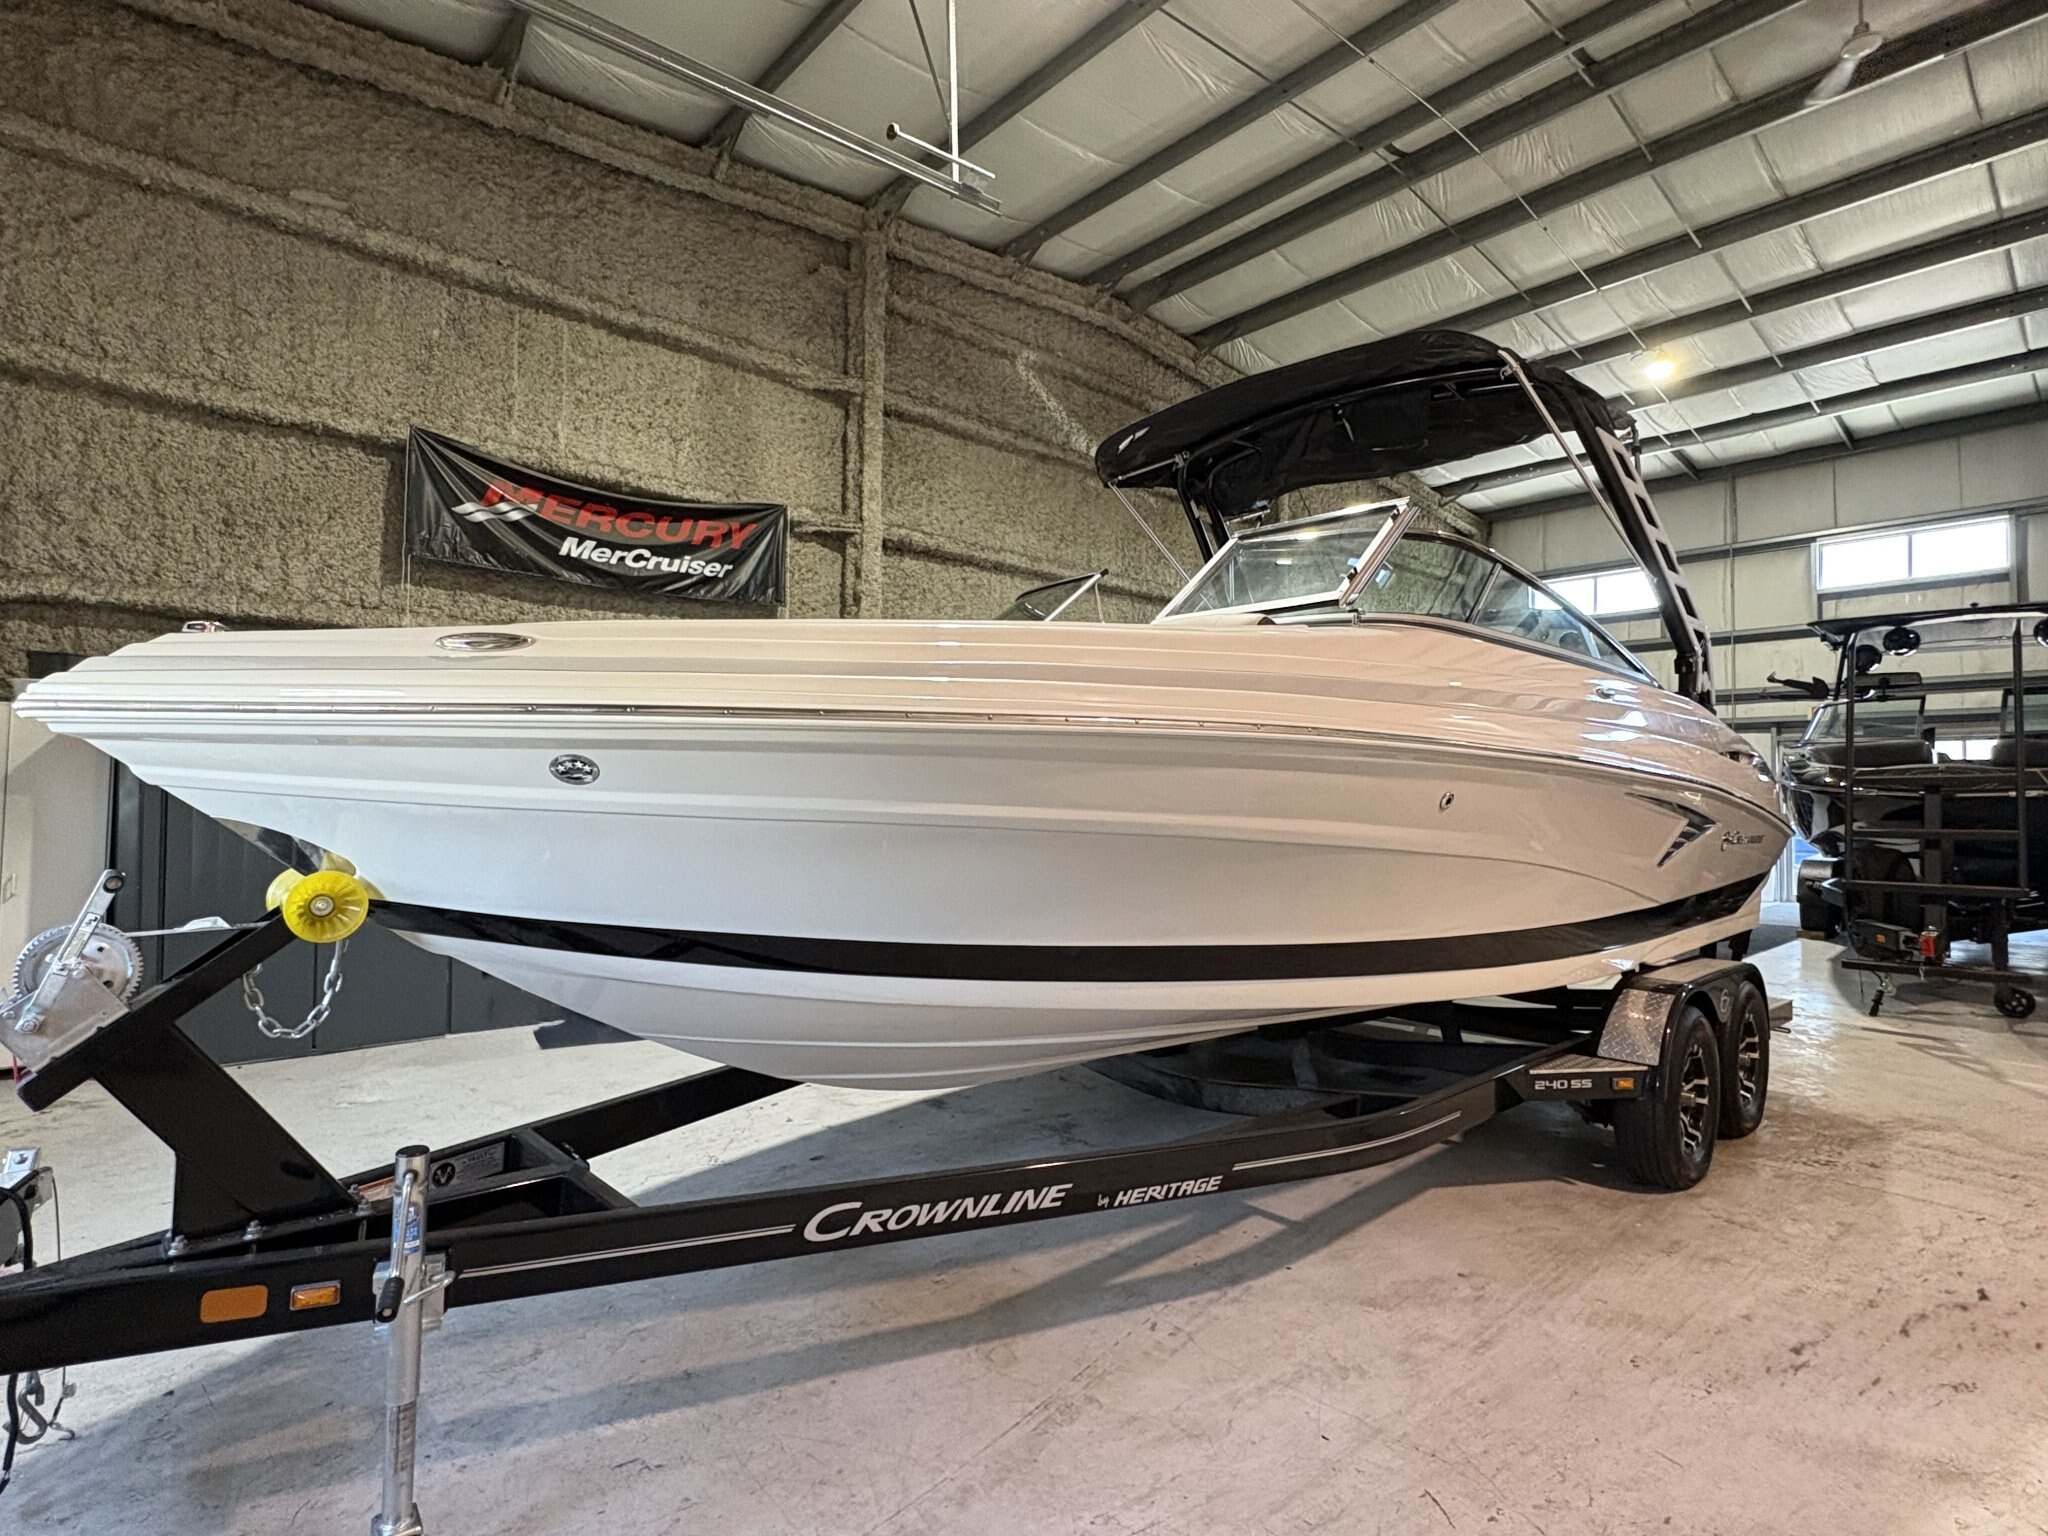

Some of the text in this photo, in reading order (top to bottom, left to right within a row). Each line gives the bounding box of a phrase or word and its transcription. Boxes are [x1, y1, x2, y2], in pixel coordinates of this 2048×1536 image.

[480, 478, 759, 550] MERCURY
[558, 536, 734, 580] MerCruiser
[1534, 1078, 1593, 1091] 240 SS
[803, 1175, 1224, 1243] CROWNLINE by HERITAGE
